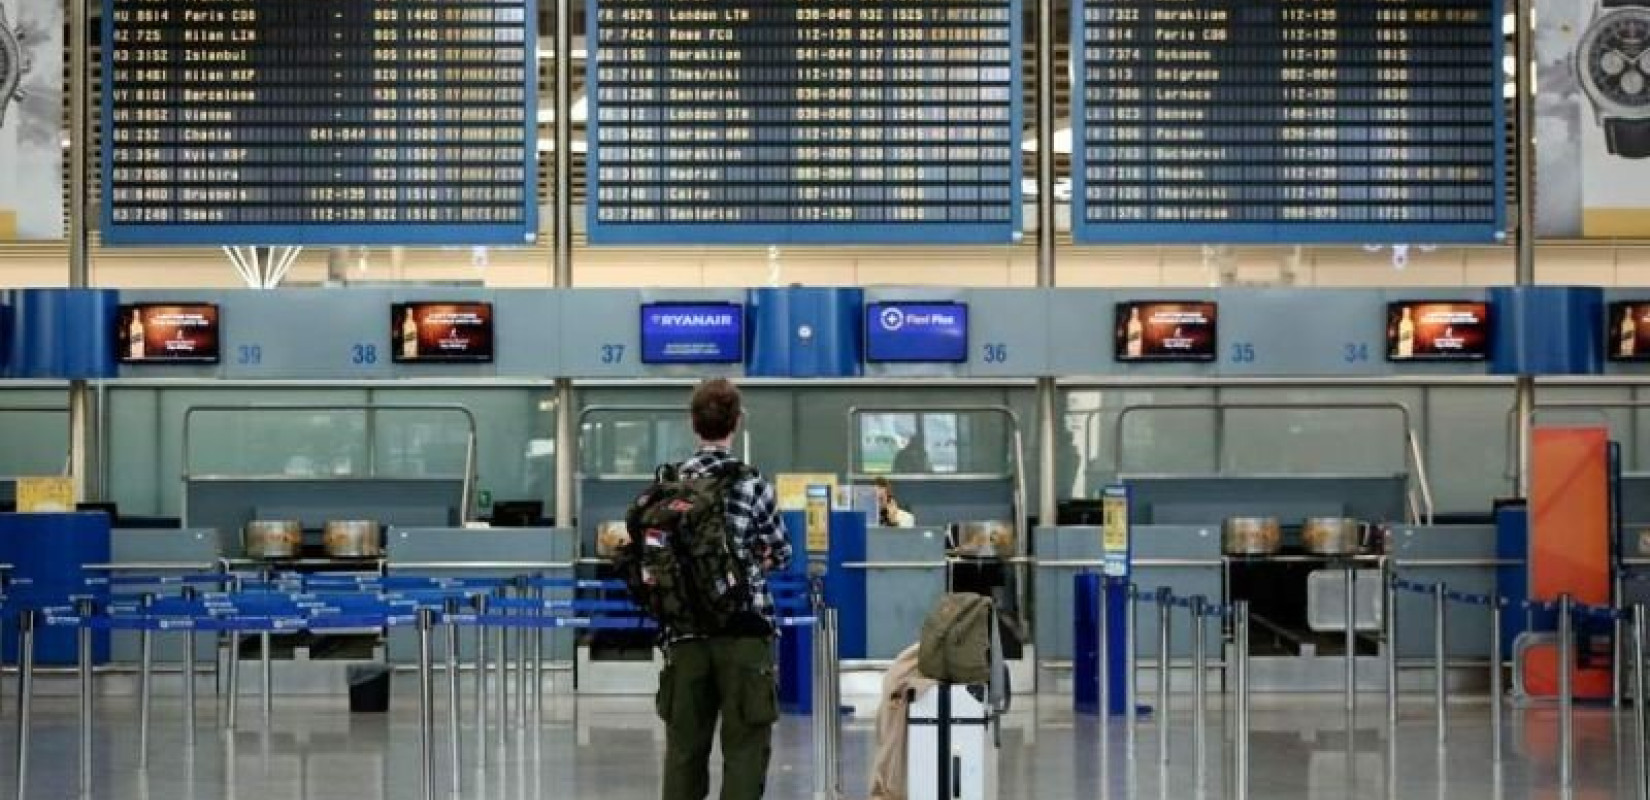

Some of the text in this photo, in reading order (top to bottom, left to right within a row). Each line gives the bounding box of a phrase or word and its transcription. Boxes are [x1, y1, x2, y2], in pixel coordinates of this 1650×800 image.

[185, 10, 224, 21] Paris
[670, 9, 716, 20] London
[185, 50, 246, 60] Istanbul
[185, 89, 255, 100] Barcelona
[185, 189, 246, 200] Brussels
[661, 314, 732, 326] RYANAIR
[932, 314, 954, 325] Plus
[238, 344, 261, 364] 39
[352, 344, 377, 364] 38
[602, 344, 625, 364] 37
[983, 343, 1007, 363] 36
[1231, 343, 1255, 362] 35
[1345, 343, 1368, 363] 34
